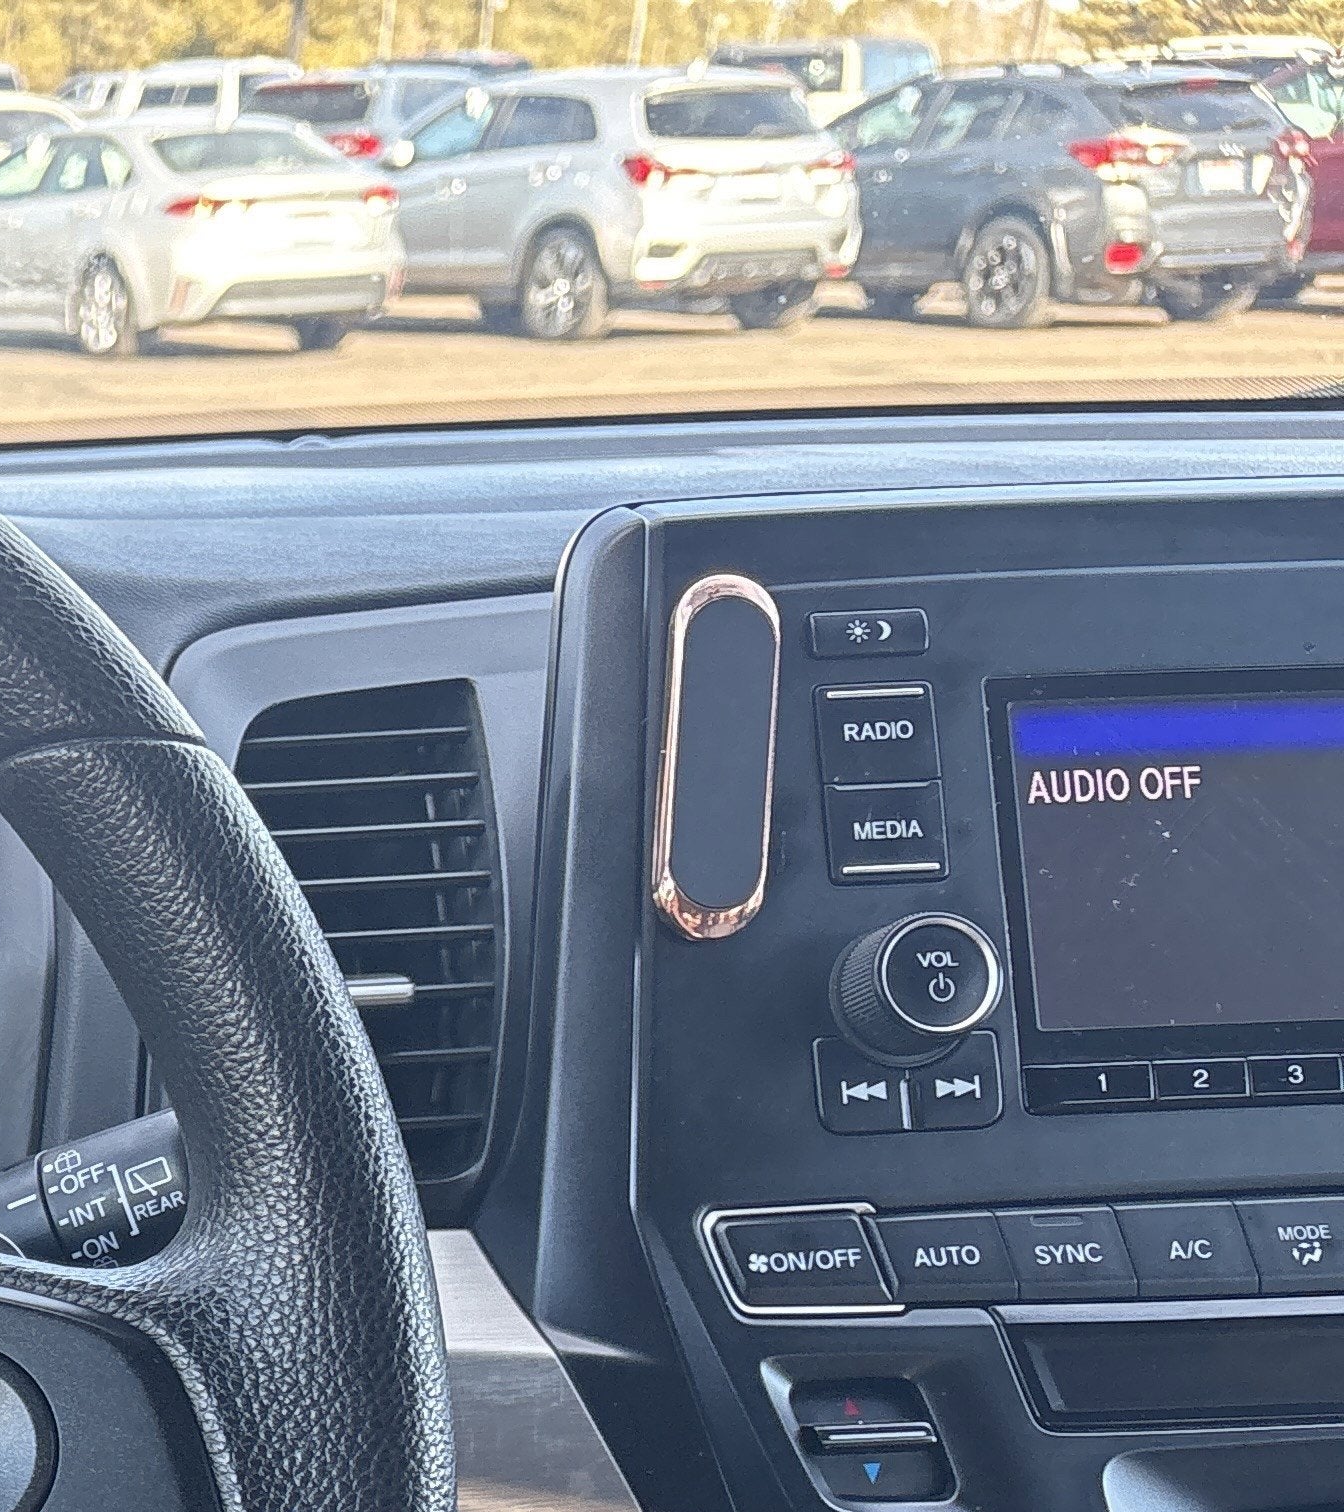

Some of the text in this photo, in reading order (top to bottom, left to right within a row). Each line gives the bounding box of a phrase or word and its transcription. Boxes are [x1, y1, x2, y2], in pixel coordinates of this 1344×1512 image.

[843, 720, 914, 742] RADIO
[1027, 765, 1201, 804] AUDIO OFF
[853, 819, 924, 841] MEDIA
[917, 951, 959, 968] VOL
[1097, 1073, 1108, 1093] 1
[1192, 1069, 1210, 1089] 2
[1287, 1065, 1304, 1085] 3
[60, 1162, 105, 1195] OFF
[68, 1196, 107, 1228] INT
[134, 1190, 187, 1222] REAR
[1277, 1224, 1333, 1241] MODE
[82, 1231, 121, 1260] ON
[914, 1245, 982, 1268] AUTO
[1034, 1242, 1104, 1265] SYNC
[1169, 1239, 1213, 1260] A/C
[769, 1248, 863, 1273] ON/OFF
